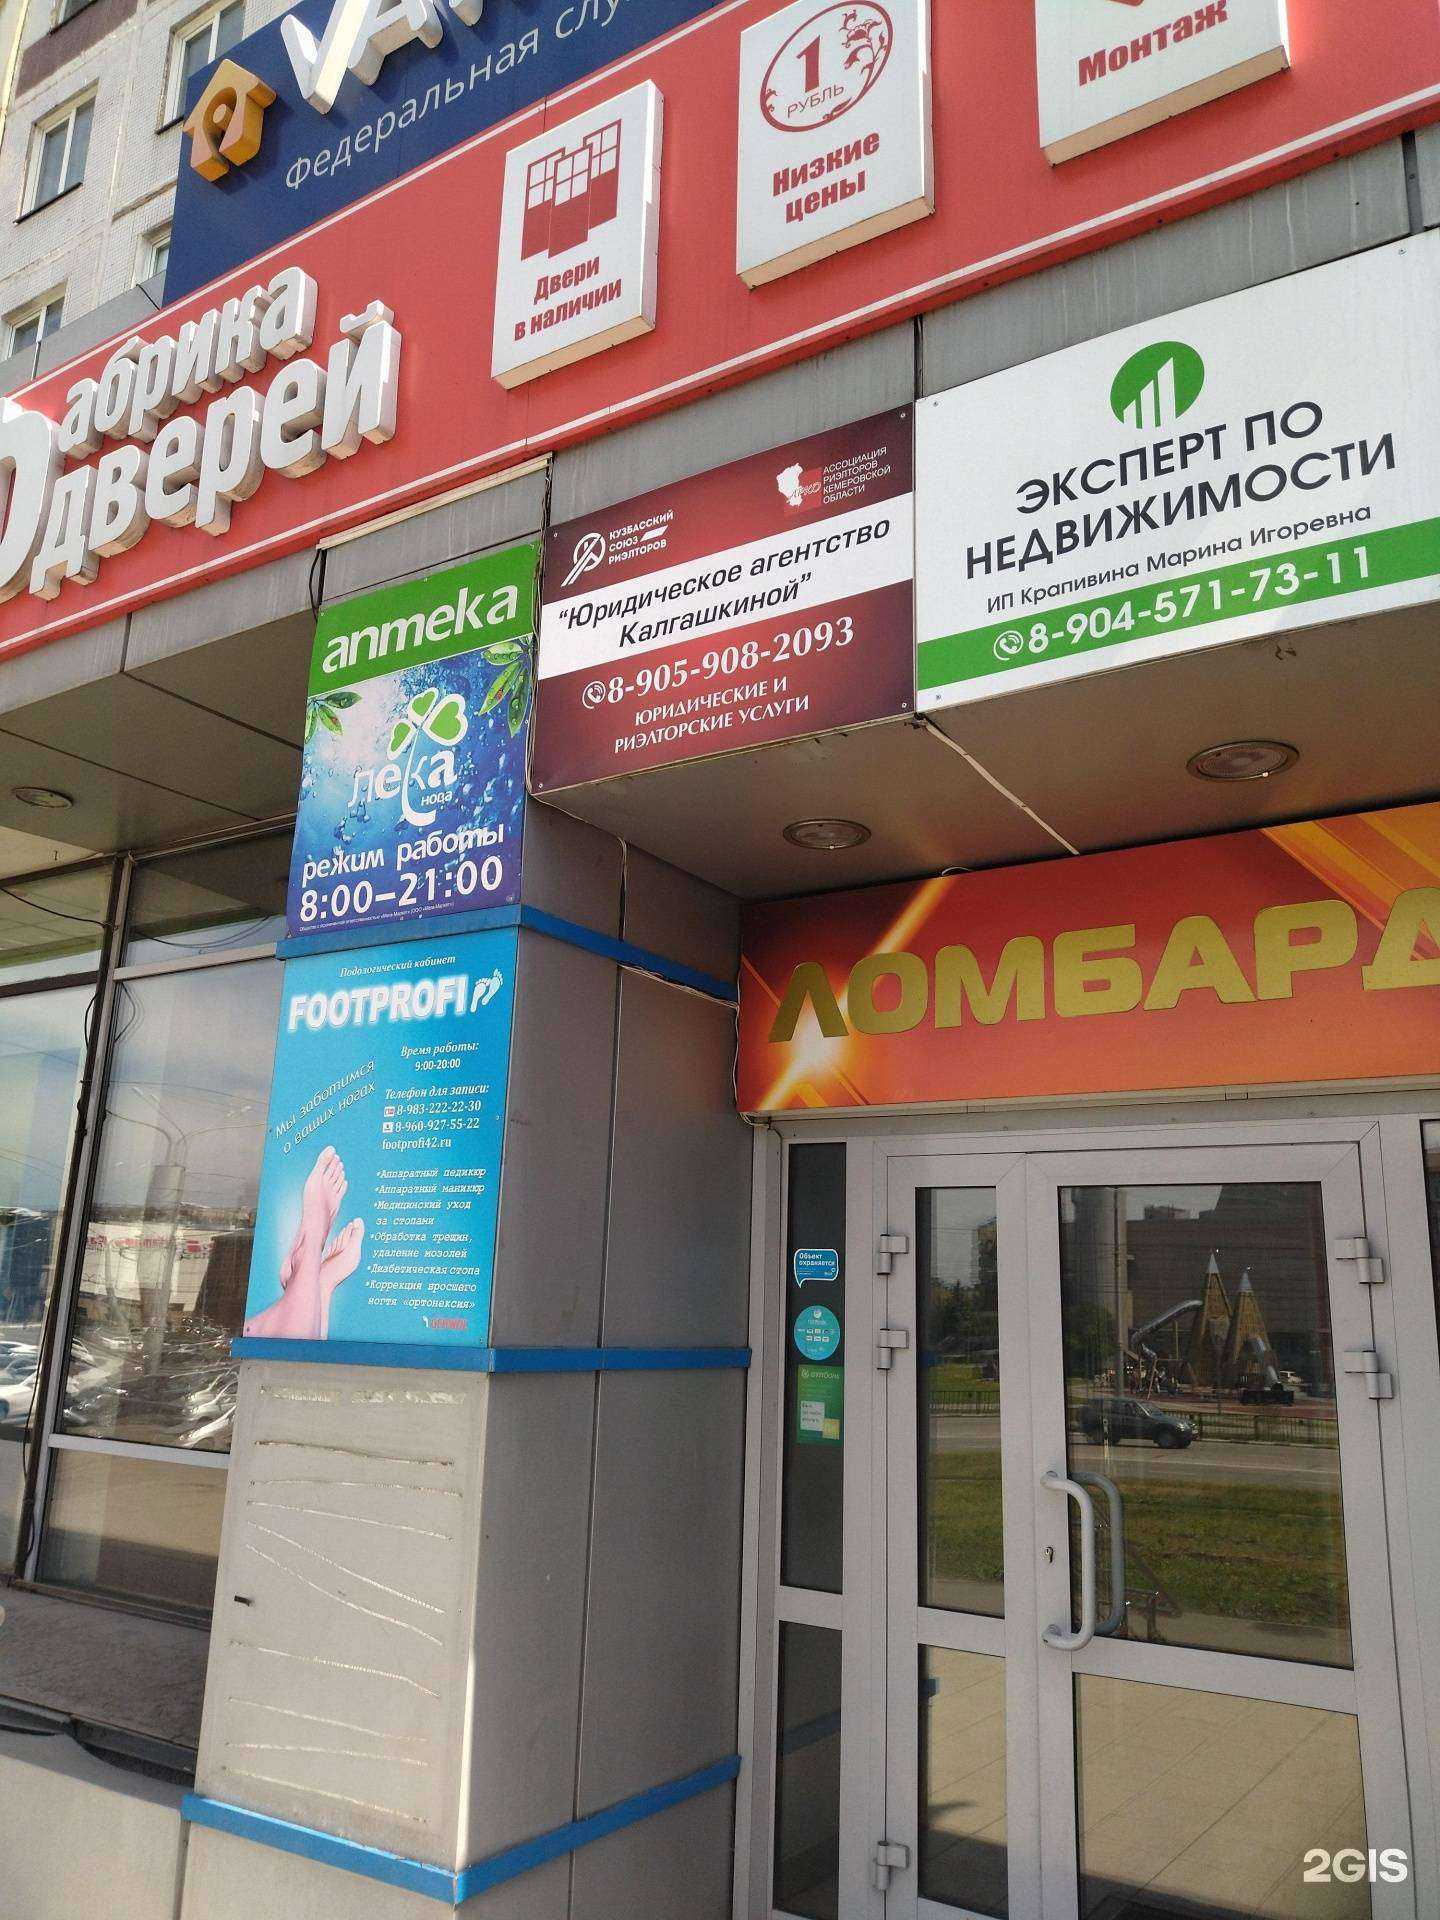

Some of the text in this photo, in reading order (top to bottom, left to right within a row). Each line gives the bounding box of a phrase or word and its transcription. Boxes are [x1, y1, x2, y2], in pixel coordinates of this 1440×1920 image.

[1078, 2, 1229, 87] Монтаж
[796, 35, 820, 93] 1
[285, 0, 633, 190] Федеральная слу
[787, 85, 844, 118] РУБЛЬ
[772, 132, 880, 197] Низкие
[785, 170, 866, 224] цены
[533, 256, 600, 305] Двери
[514, 278, 622, 341] в наличии
[29, 299, 402, 600] дверей
[822, 446, 888, 475] АССОЦИАЦИЯ
[1016, 401, 1323, 515] ЭКСПЕРТ ПО
[822, 460, 878, 485] РИЭЛТОРОВ
[822, 465, 891, 495] КЕМЕРОВСКОЙ
[823, 484, 865, 504] ОБЛАСТИ
[966, 432, 1396, 580] НЕДВИЖИМОСТИ
[609, 509, 674, 540] КУЗБАССКИЙ
[608, 535, 639, 552] СОЮЗ
[608, 538, 668, 565] РИЭЛТОРОВ
[750, 519, 890, 577] агентство
[987, 506, 1372, 614] ИП Крапивина Марина Игоревна
[1028, 546, 1369, 654] 8-904-571-73-11
[606, 615, 854, 705] 8-905-908-2093
[635, 676, 788, 727] ЮРИДИЧЕСКИЕ И
[615, 694, 810, 754] РИЭЛТОРСКИЕ УСЛУГИ
[302, 824, 504, 888] режим работы
[414, 955, 456, 968] кабинет
[769, 887, 1440, 1044] ЛОМБАРД
[287, 974, 468, 1033] FOOTPROFI
[401, 1041, 480, 1059] Время работы:
[415, 1058, 461, 1072] 9:00-20:00
[276, 1060, 375, 1139] Мы заботимся
[385, 1084, 490, 1101] Телефон для записи:
[396, 1100, 482, 1116] 8-983-222-22-30
[283, 1081, 376, 1154] о ваших ногах
[395, 1117, 481, 1133] 8-960-927-55-22
[382, 1137, 452, 1152] footprofi42.ru
[441, 1184, 485, 1195] маникюр
[443, 1168, 487, 1179] педикюр
[393, 1217, 435, 1225] стопами
[446, 1200, 472, 1210] уход
[372, 1248, 468, 1259] удаление мозолей
[449, 1267, 480, 1275] стопа
[367, 1297, 398, 1306] ногтя
[427, 1282, 477, 1293] вросшего
